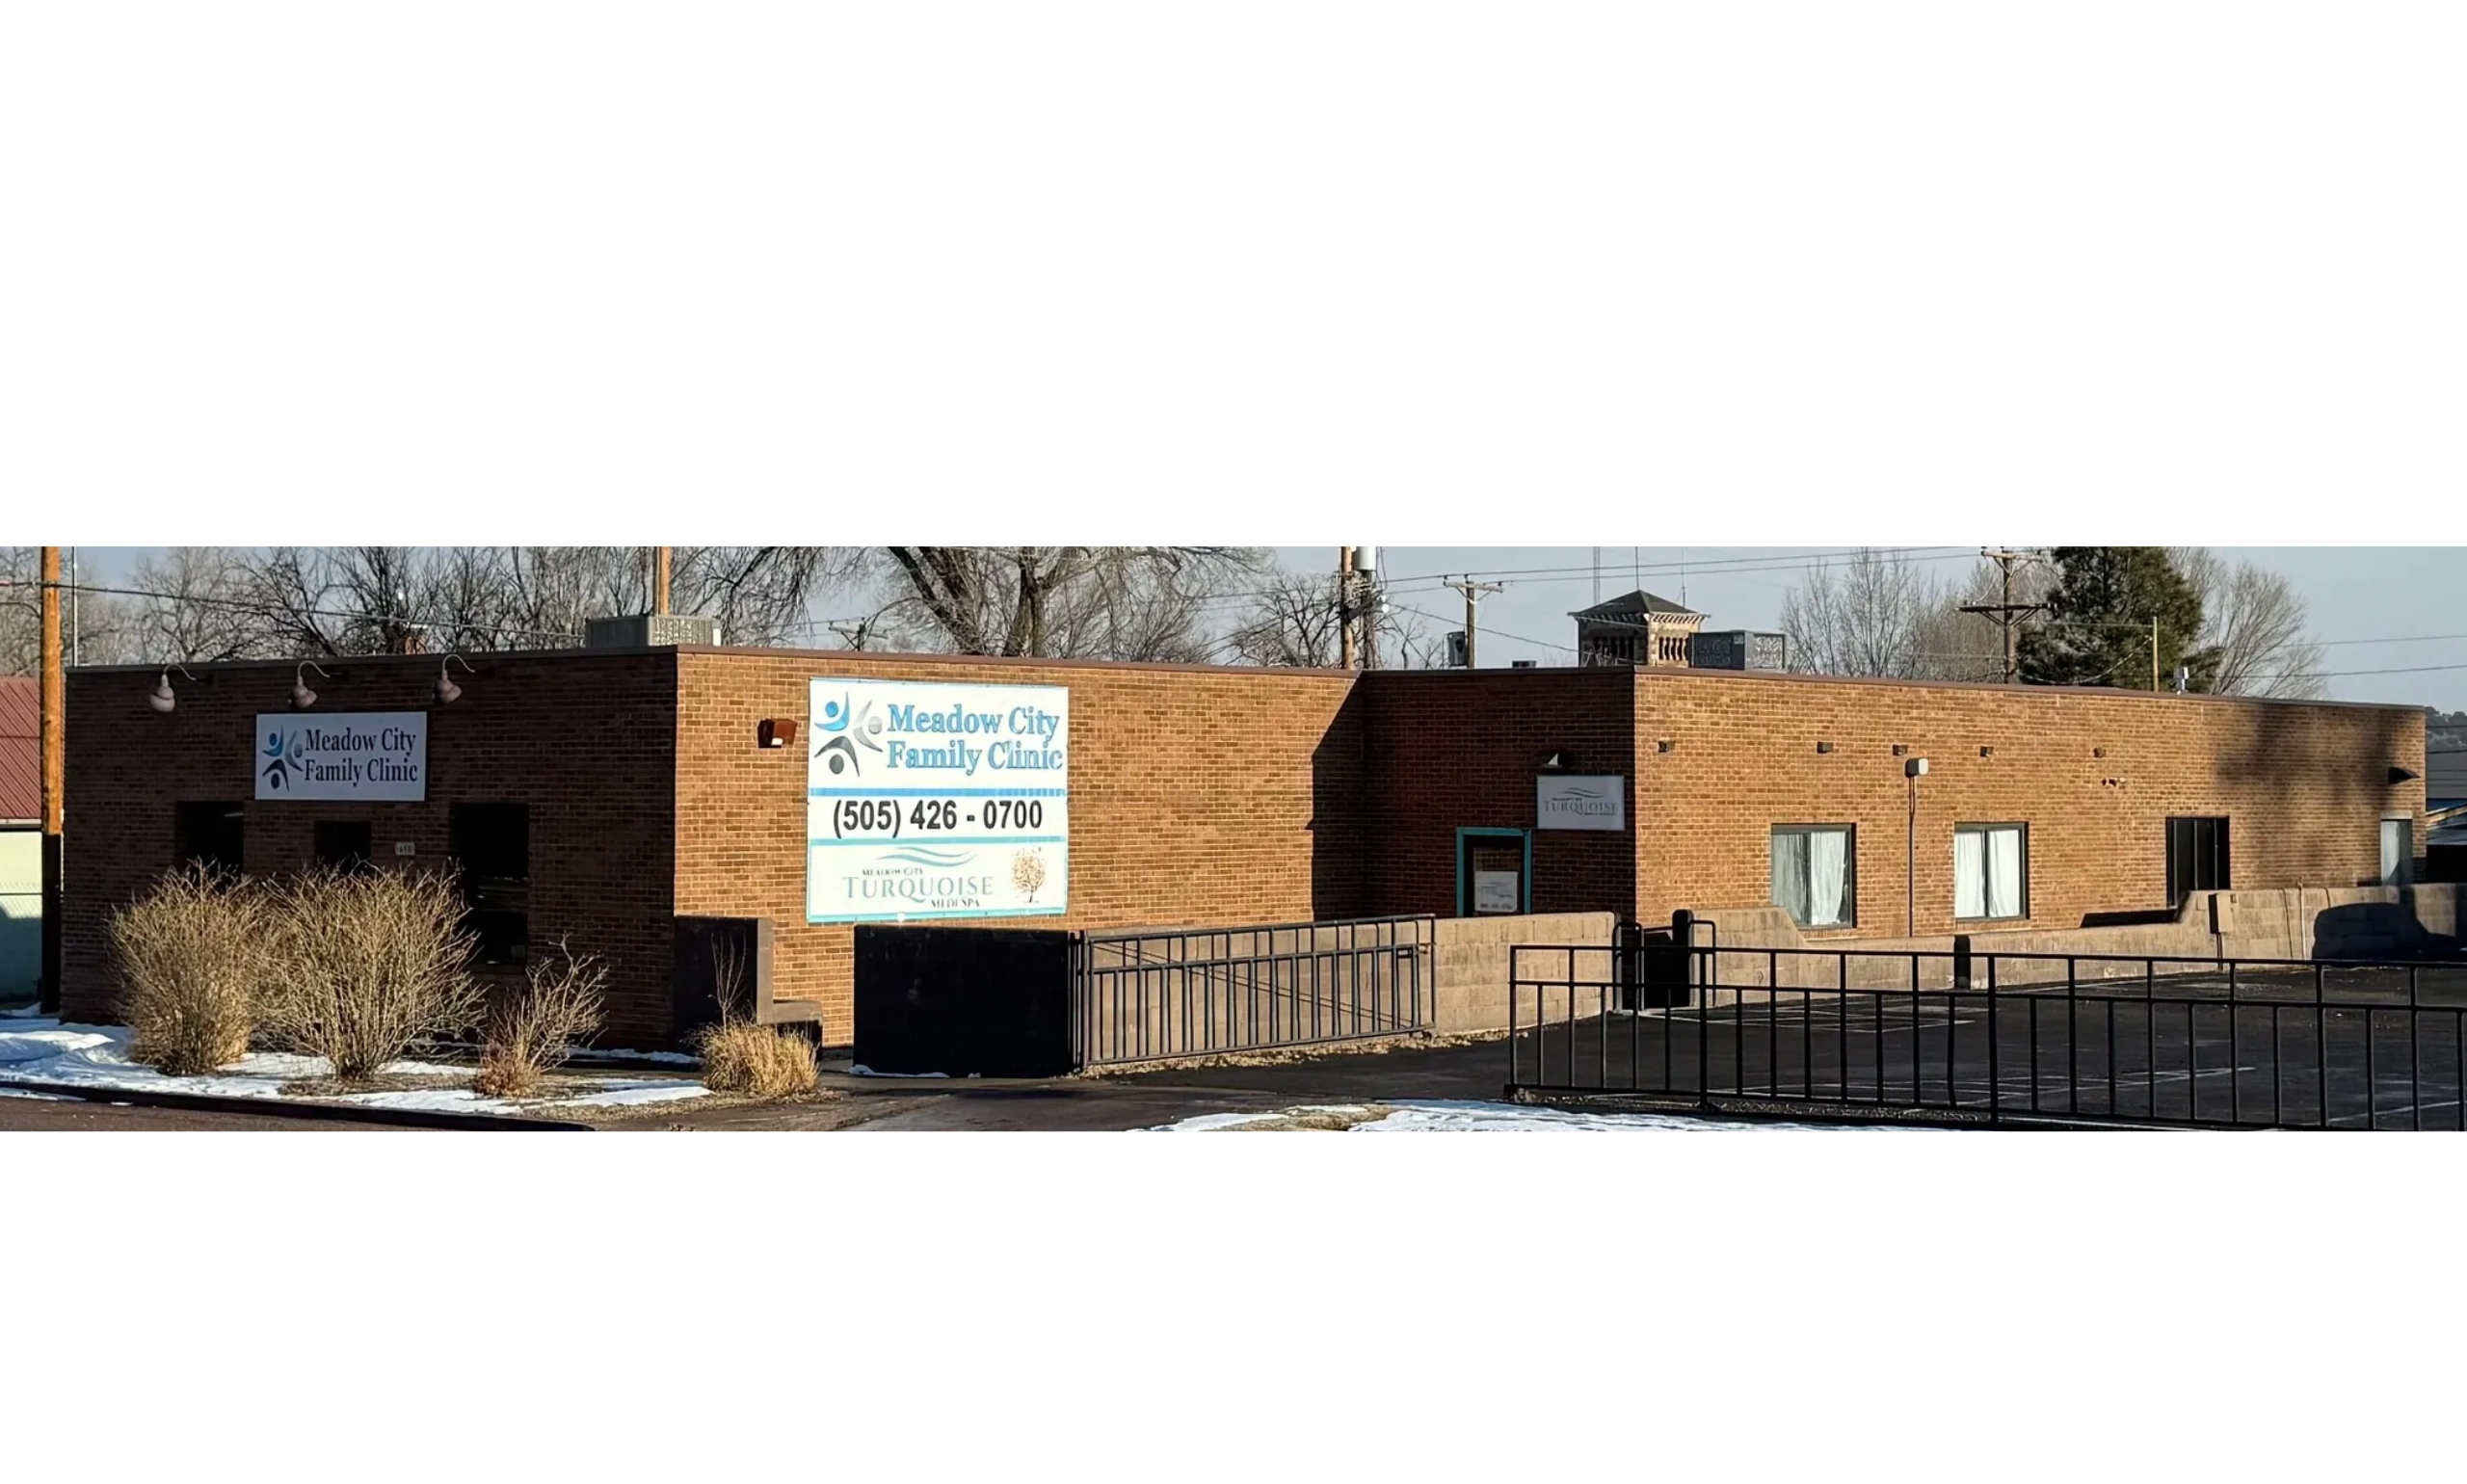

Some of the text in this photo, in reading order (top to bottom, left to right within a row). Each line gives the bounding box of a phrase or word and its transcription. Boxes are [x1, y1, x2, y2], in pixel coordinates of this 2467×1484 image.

[887, 703, 1060, 744] Meadow City
[305, 727, 416, 756] Meadow City
[305, 757, 418, 787] Family Clinic
[887, 740, 1063, 776] Family Clinic
[833, 799, 901, 839] (505)
[910, 799, 958, 830] 426
[983, 799, 1043, 829] 0700
[1542, 801, 1618, 815] TURQUOISE
[841, 876, 994, 903] TURQUOISE
